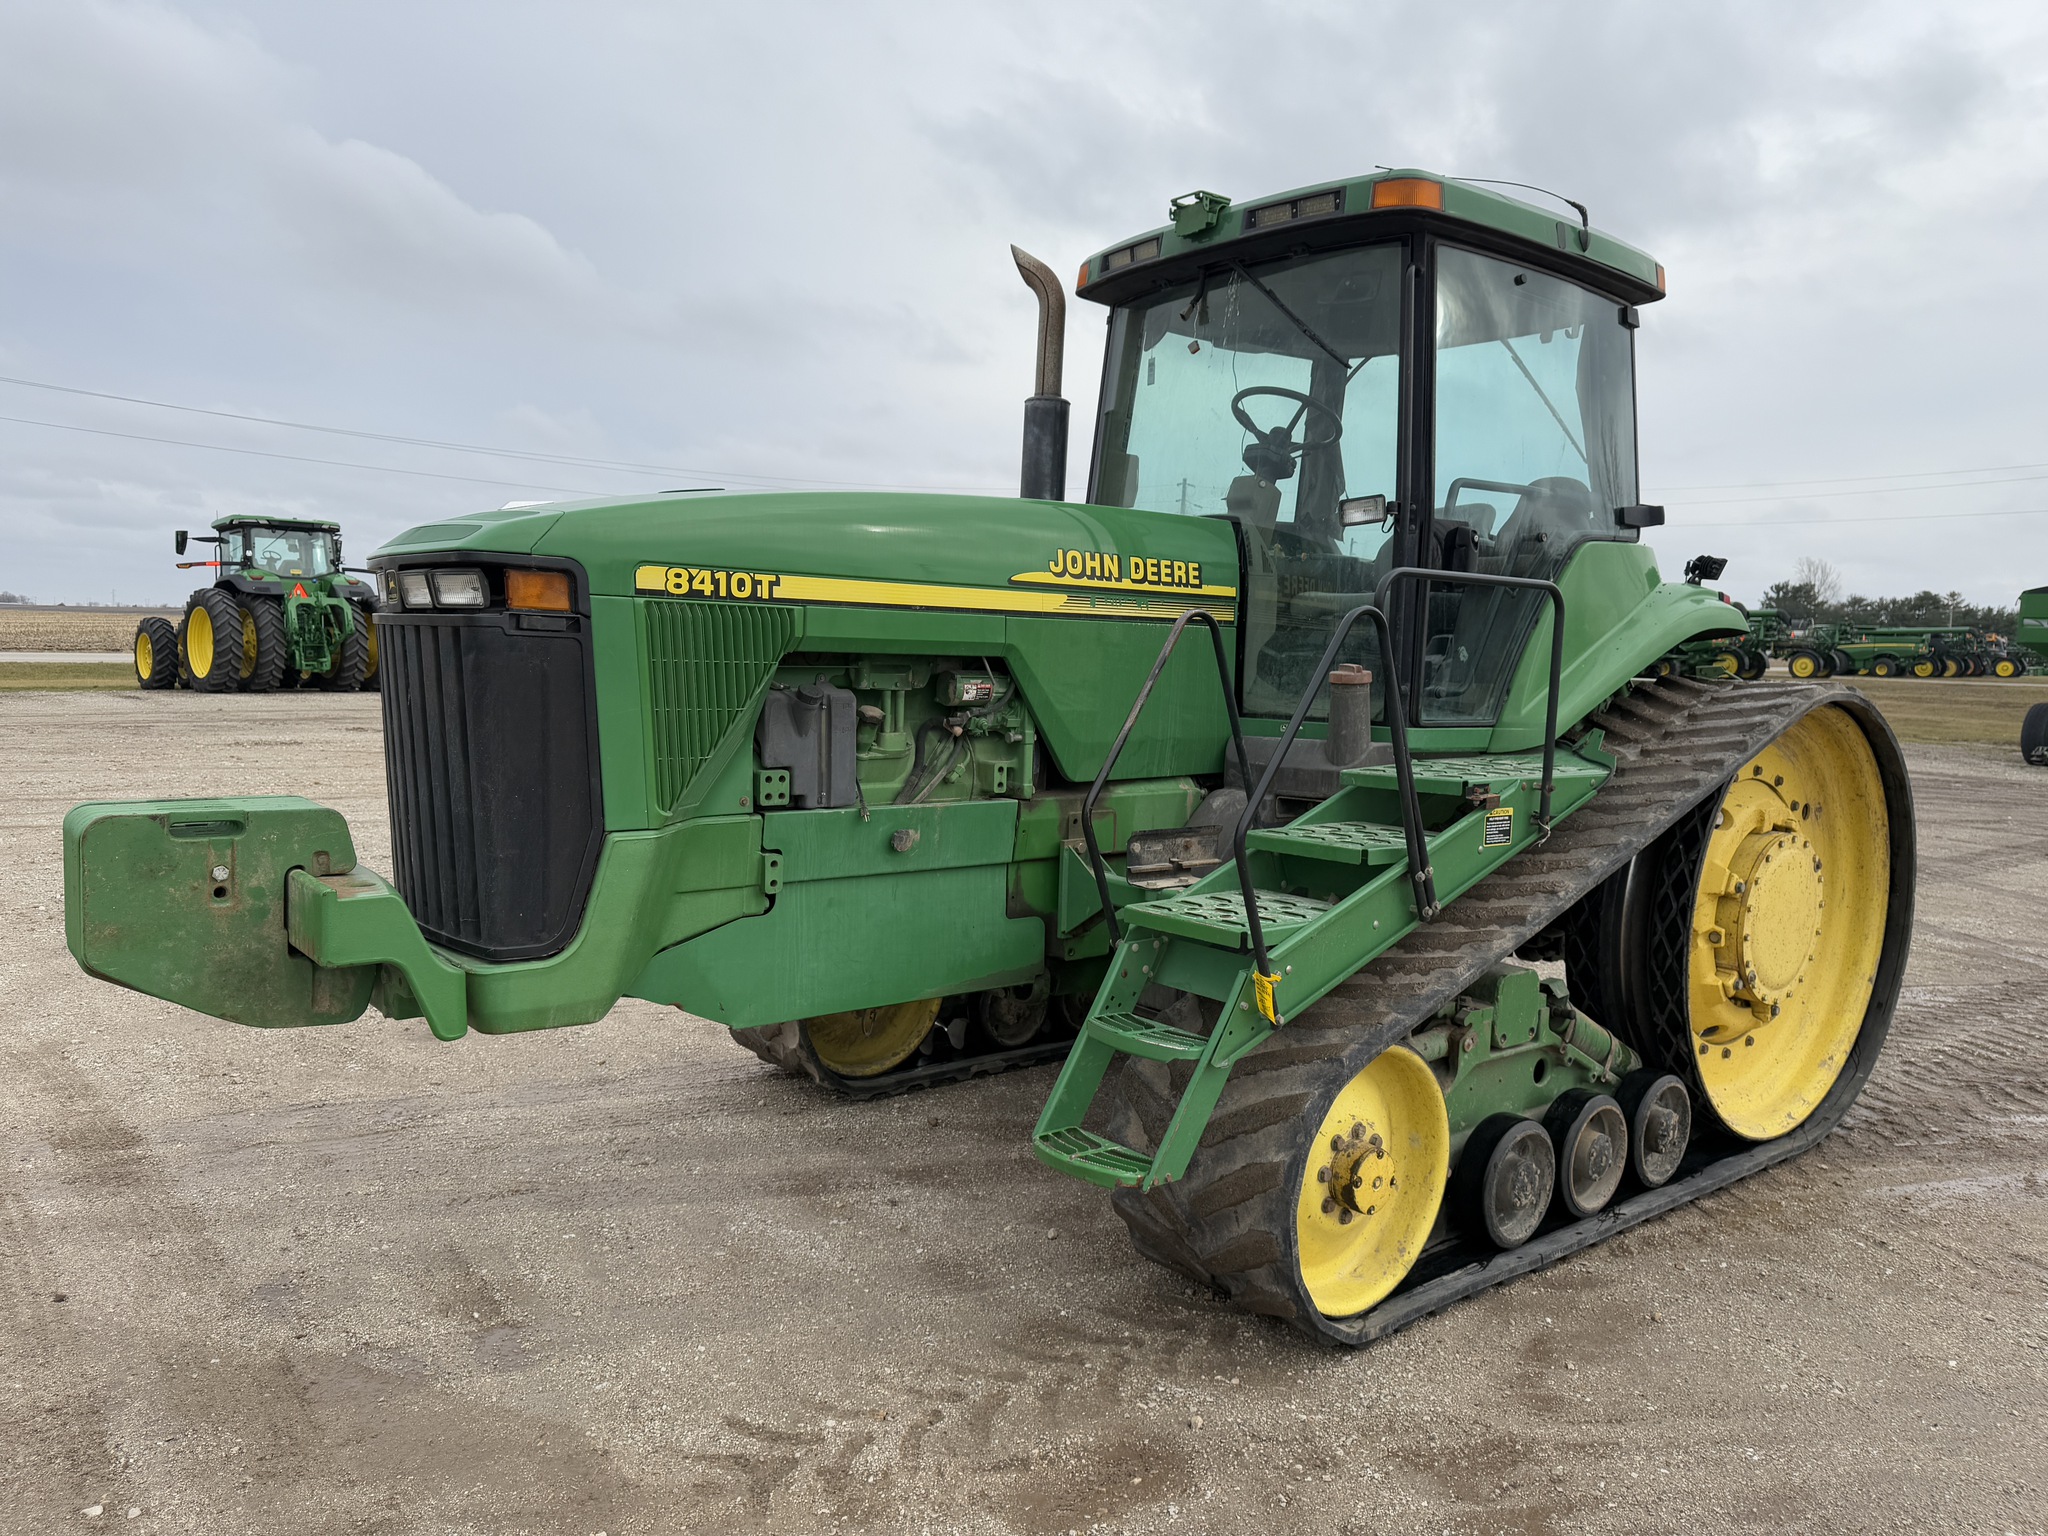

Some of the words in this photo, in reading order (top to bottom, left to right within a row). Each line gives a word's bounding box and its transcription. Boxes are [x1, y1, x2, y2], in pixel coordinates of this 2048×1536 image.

[665, 567, 778, 600] 8410T
[1049, 548, 1121, 582] JOHN
[1129, 556, 1202, 587] DEERE
